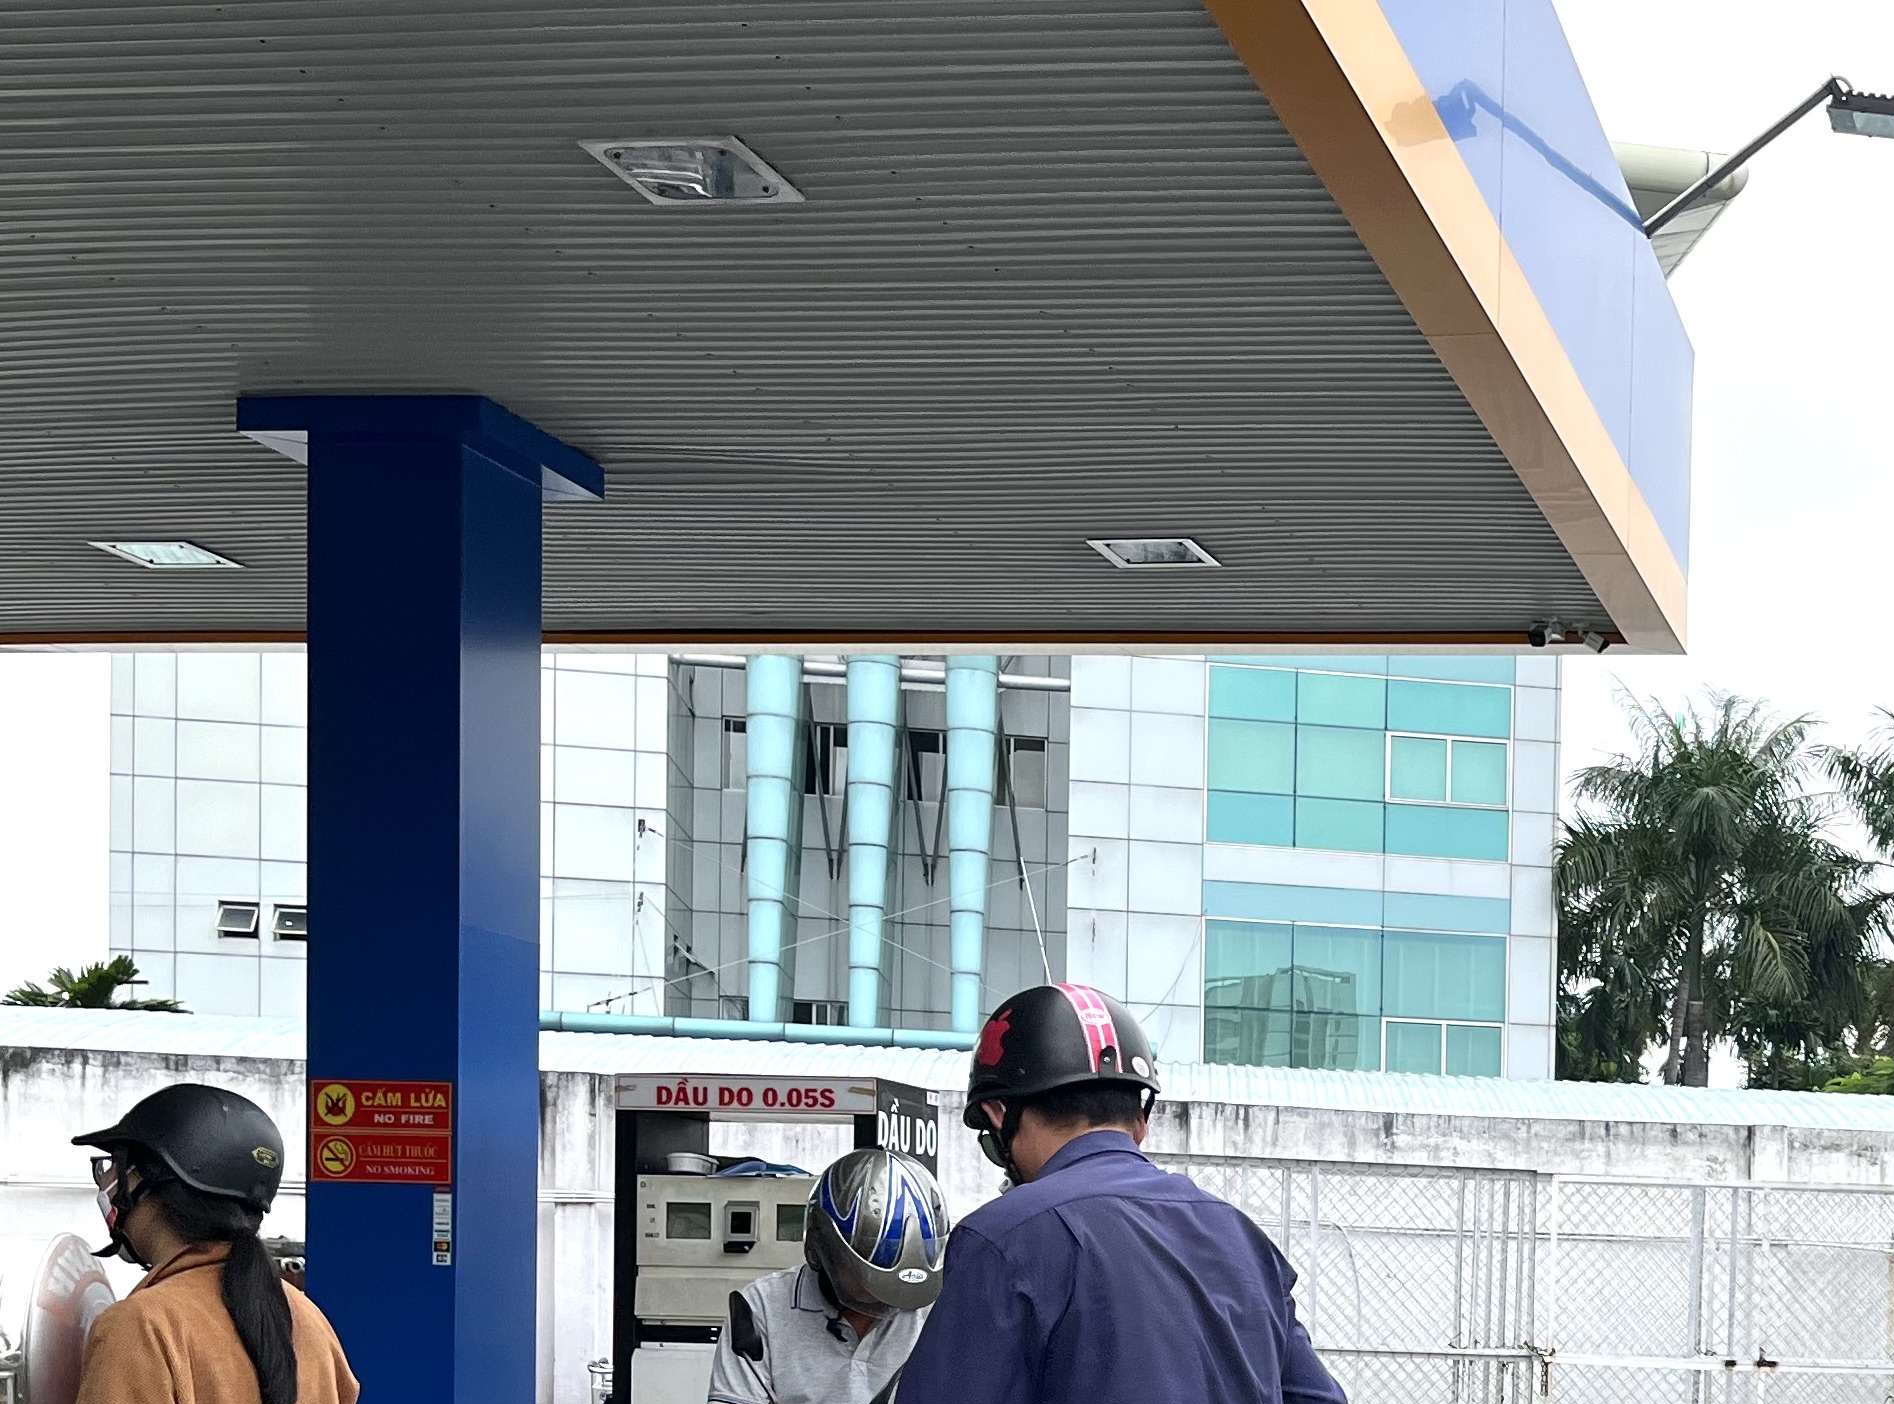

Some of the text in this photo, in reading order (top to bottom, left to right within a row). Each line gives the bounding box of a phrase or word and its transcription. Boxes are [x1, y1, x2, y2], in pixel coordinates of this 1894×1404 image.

[360, 1087, 447, 1107] CẤM LỬA
[656, 1077, 836, 1108] DẦU DO 0.05S
[373, 1113, 434, 1125] NO FIRE
[877, 1098, 937, 1157] DẦU DO
[365, 1164, 435, 1175] NO SMOKING
